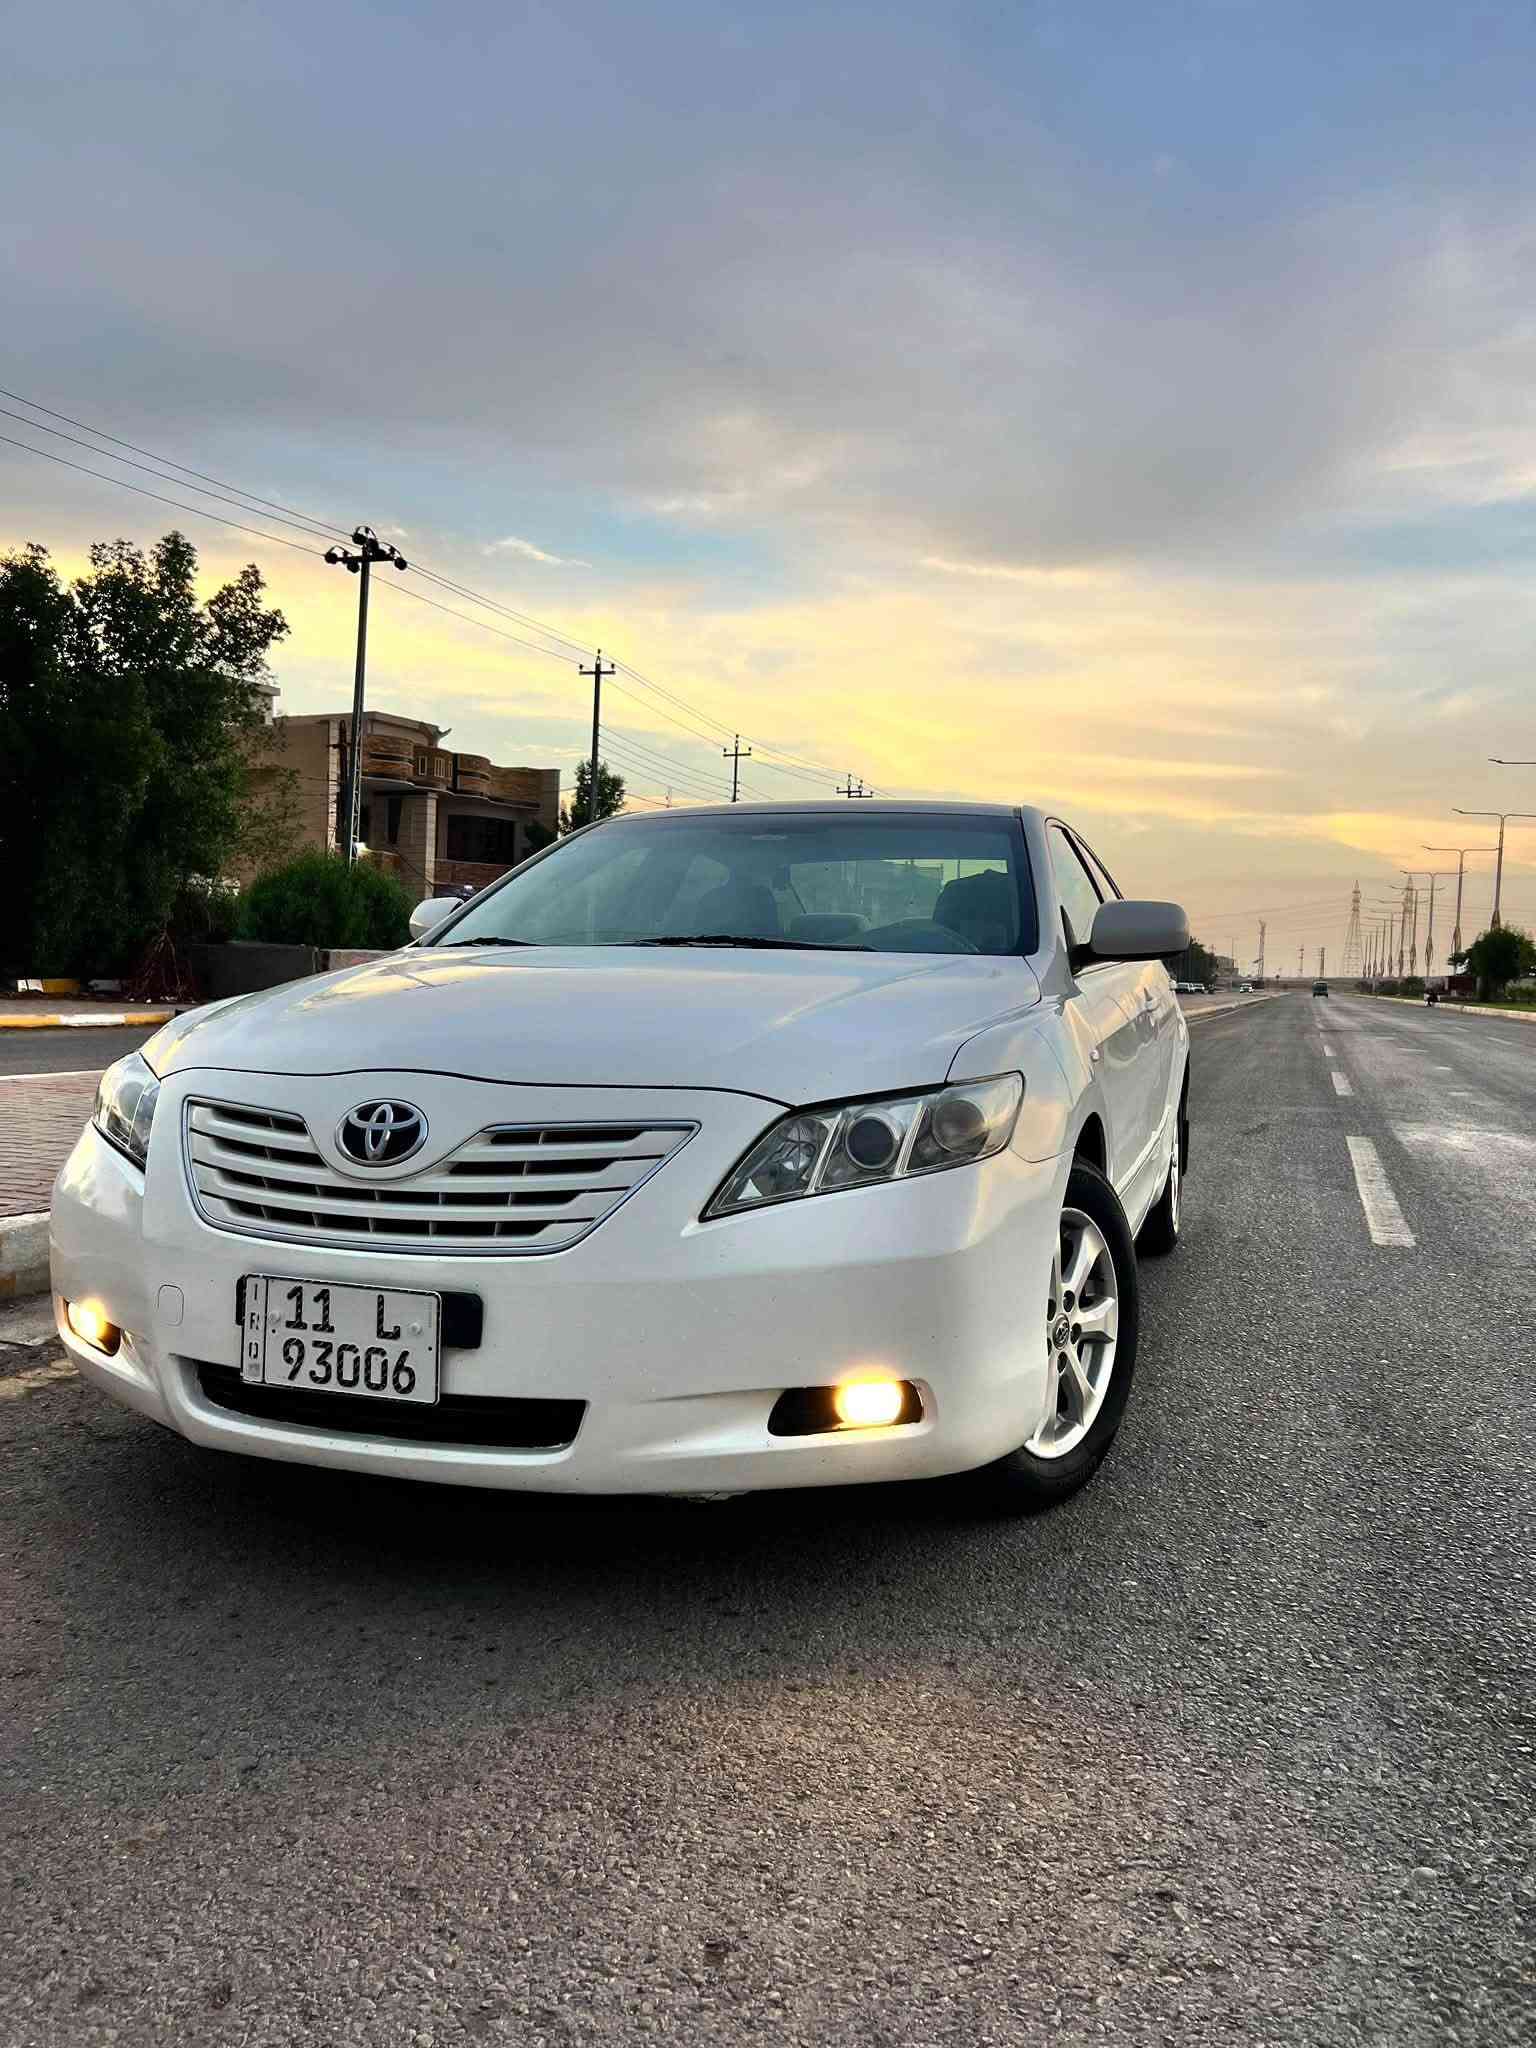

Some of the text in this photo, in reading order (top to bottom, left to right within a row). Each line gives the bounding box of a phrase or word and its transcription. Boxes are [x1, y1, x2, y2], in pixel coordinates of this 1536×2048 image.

[286, 1286, 335, 1333] 11
[377, 1294, 401, 1340] L
[283, 1338, 416, 1395] 93006
